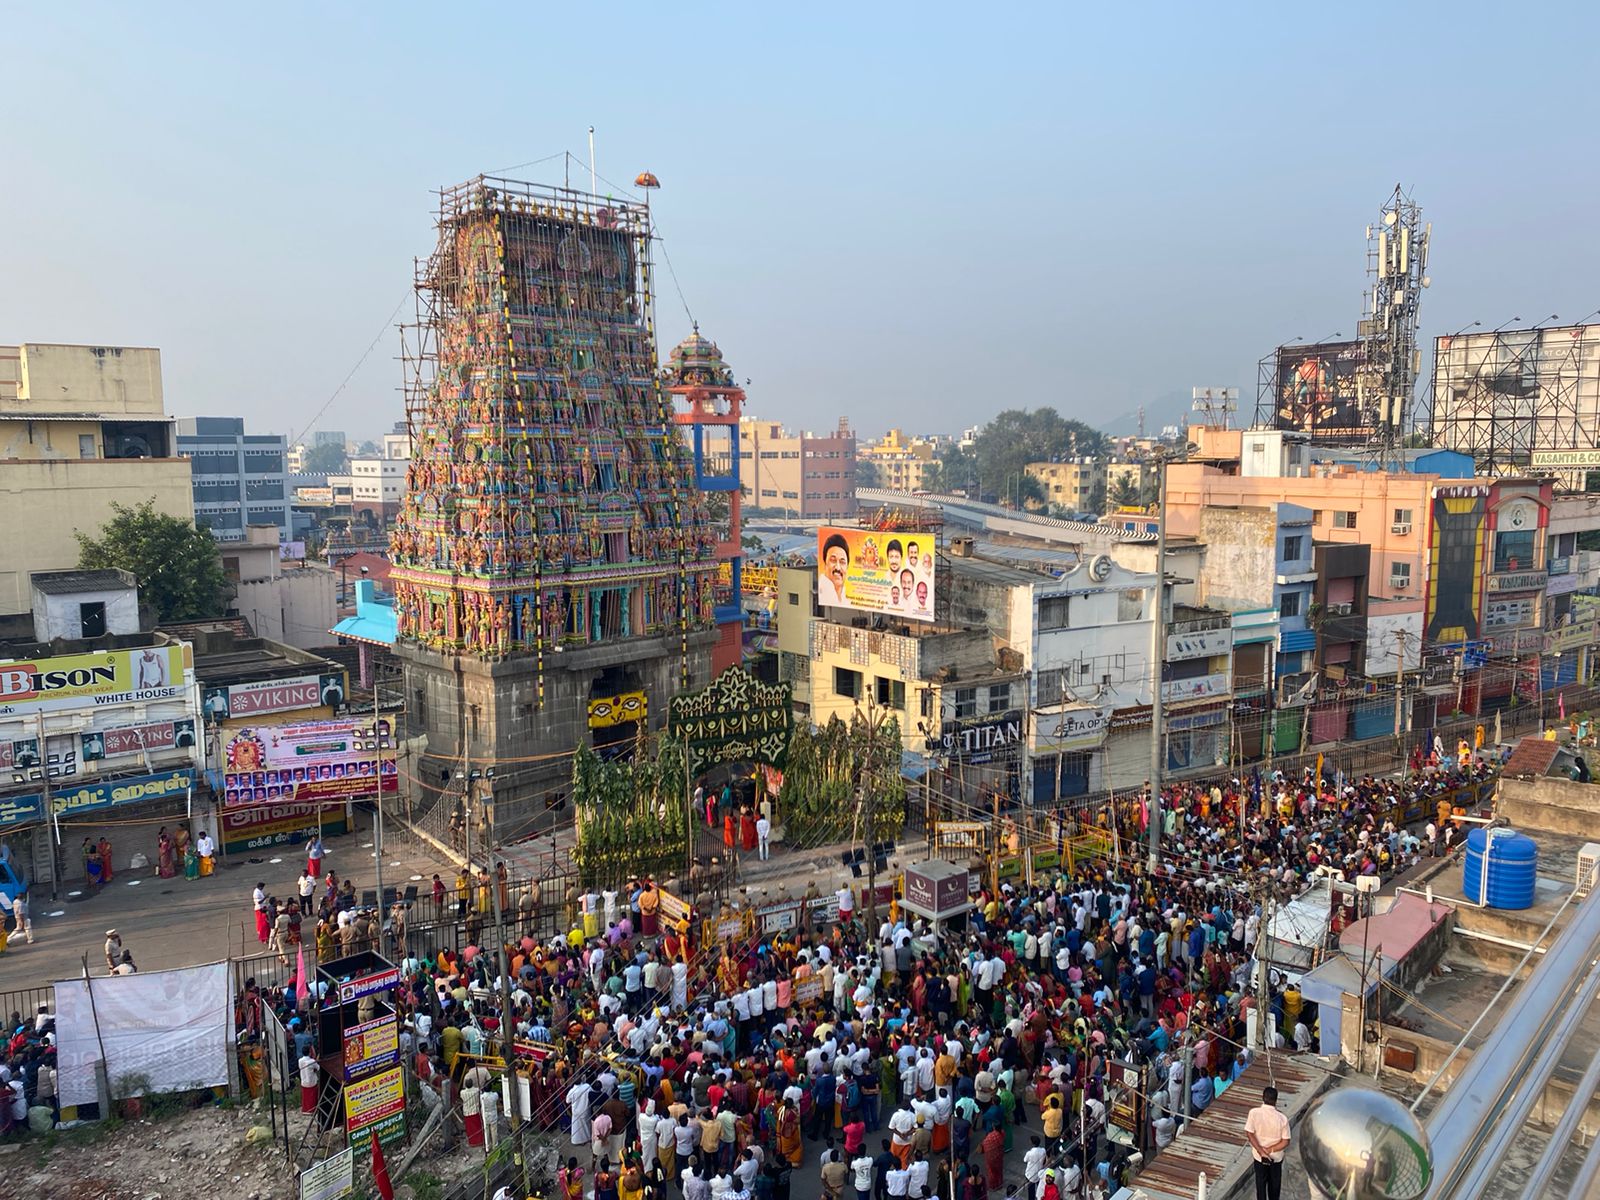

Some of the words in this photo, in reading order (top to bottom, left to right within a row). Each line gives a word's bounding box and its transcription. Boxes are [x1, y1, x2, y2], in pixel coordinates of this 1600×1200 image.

[1534, 453, 1578, 464] VASANTH
[0, 664, 116, 696] BISON
[95, 693, 133, 704] WHITE
[136, 687, 176, 700] HOUSE
[251, 687, 317, 707] VIKING
[961, 720, 1020, 751] TITAN
